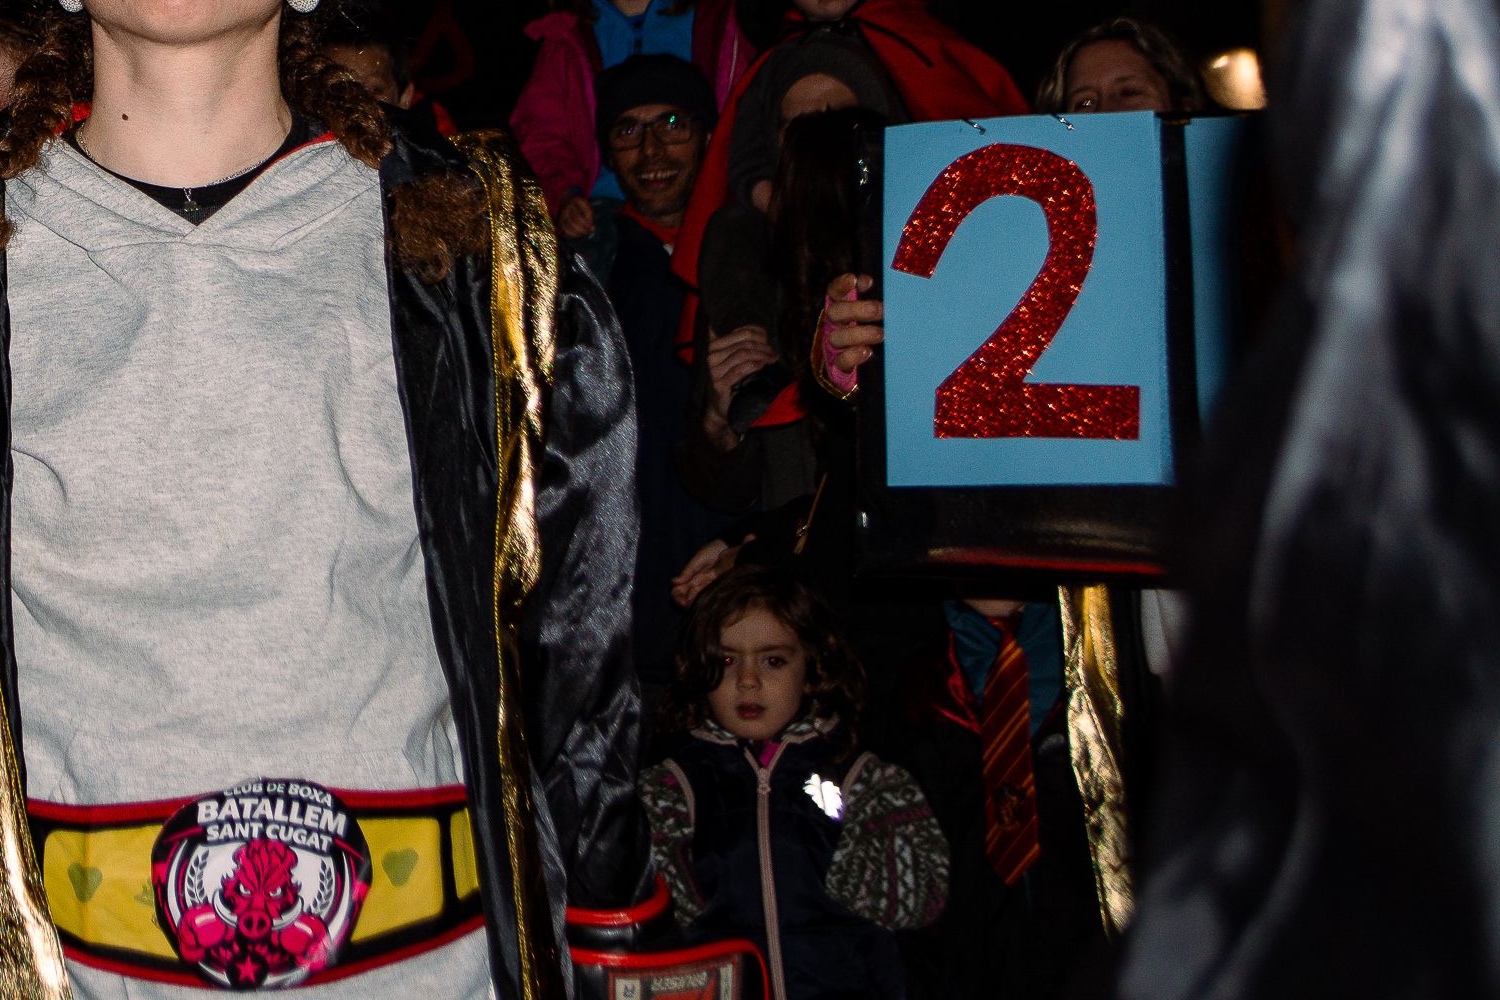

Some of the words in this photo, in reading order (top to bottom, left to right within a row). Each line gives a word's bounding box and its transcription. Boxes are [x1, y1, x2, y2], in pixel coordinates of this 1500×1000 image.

[891, 143, 1140, 440] 2
[223, 782, 263, 797] CLUB
[266, 782, 286, 794] DE
[288, 783, 333, 808] BOXA
[197, 797, 348, 838] BATALLEM
[206, 822, 264, 842] SANT
[265, 823, 334, 853] CUGAT
